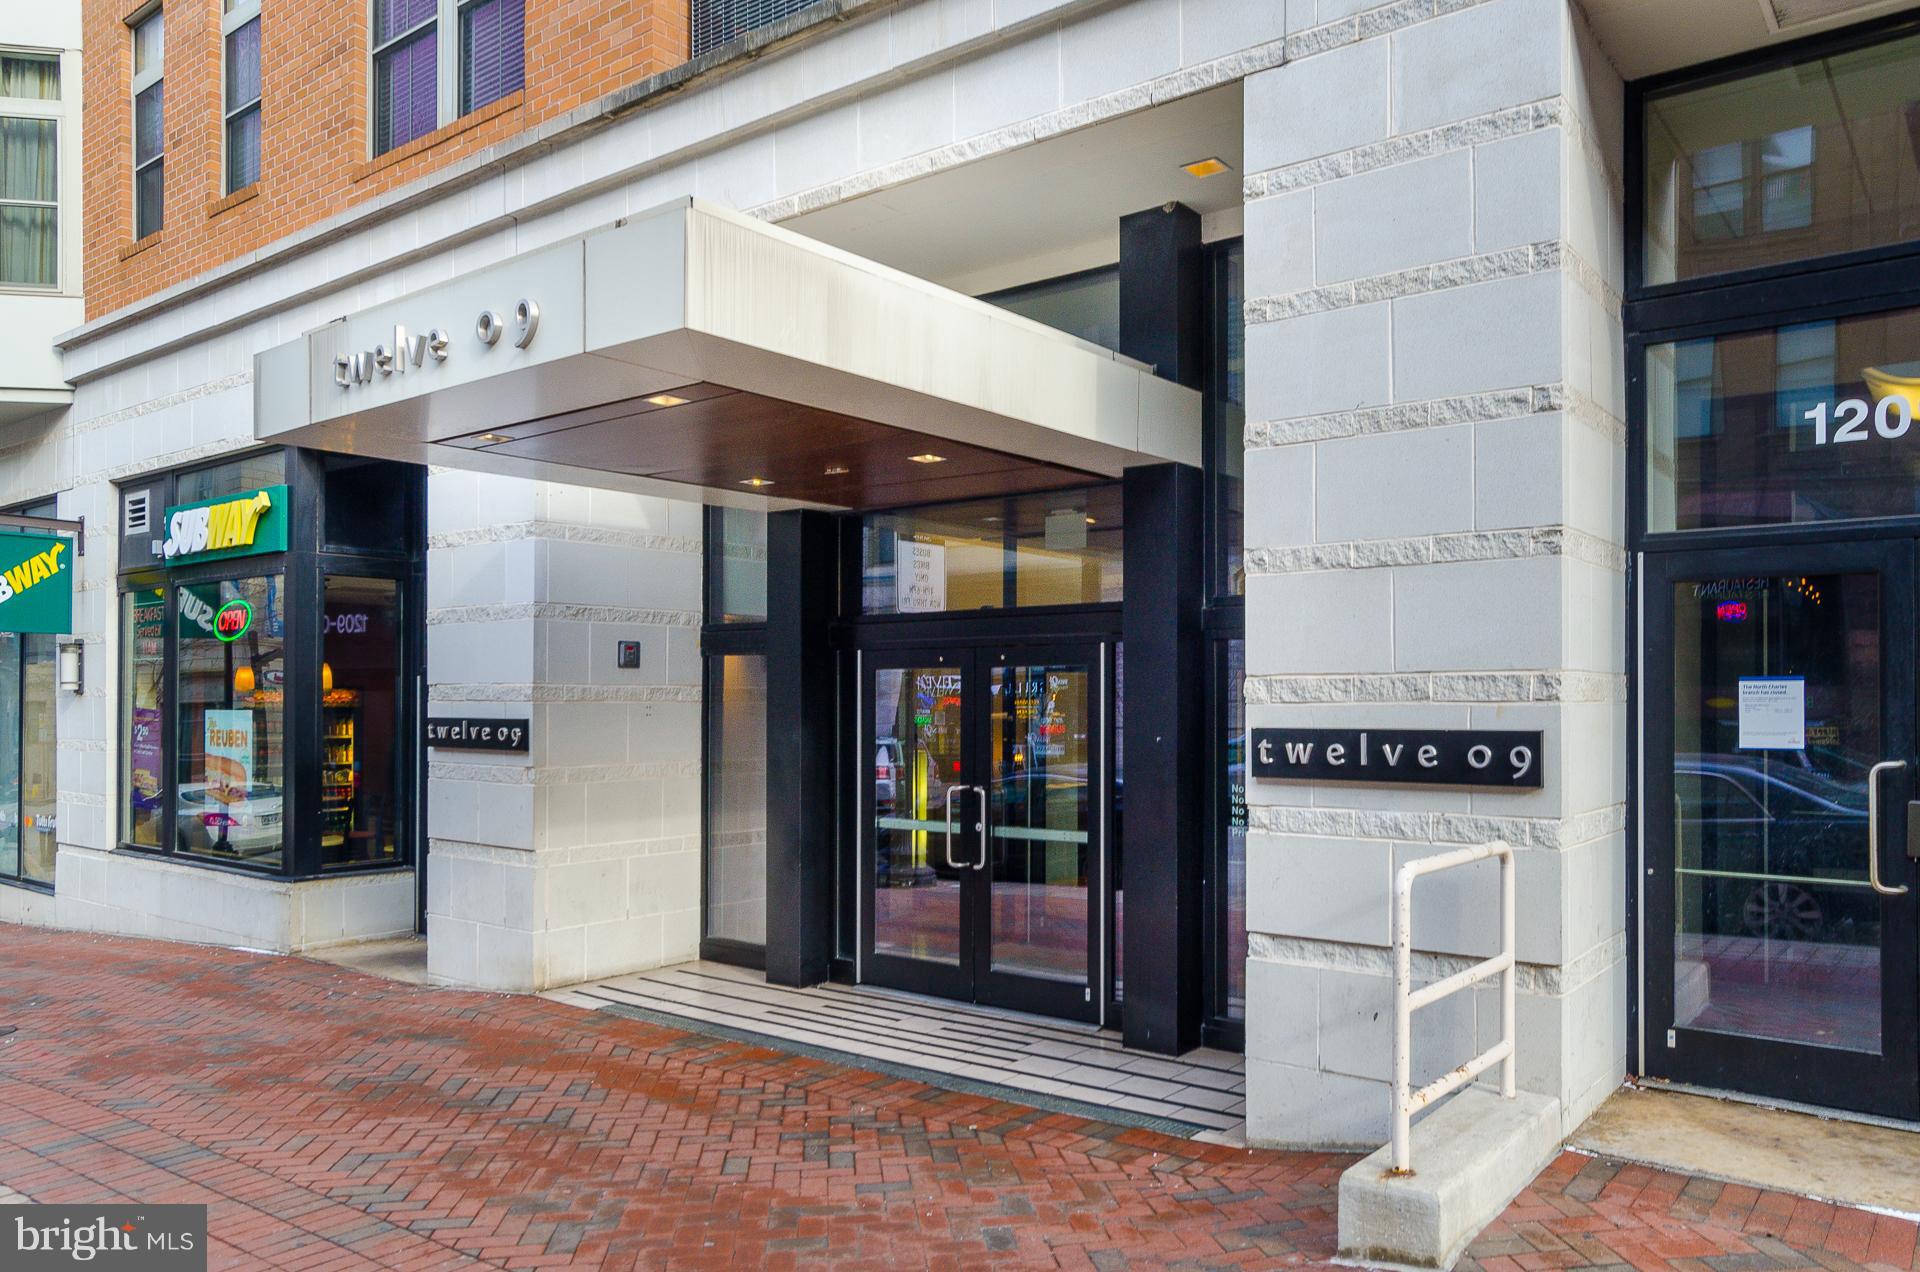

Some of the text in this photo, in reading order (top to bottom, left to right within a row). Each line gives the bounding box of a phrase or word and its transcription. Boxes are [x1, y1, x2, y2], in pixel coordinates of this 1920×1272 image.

[333, 324, 449, 388] twelve
[1804, 395, 1920, 445] 120
[163, 491, 271, 559] SUBWAY
[218, 609, 247, 632] OPEN
[209, 728, 249, 748] REUBEN
[427, 720, 491, 741] twelve
[1257, 733, 1439, 768] twelve
[1231, 783, 1245, 793] No
[1231, 794, 1245, 805] No
[1231, 805, 1245, 816] No
[1231, 816, 1245, 827] No
